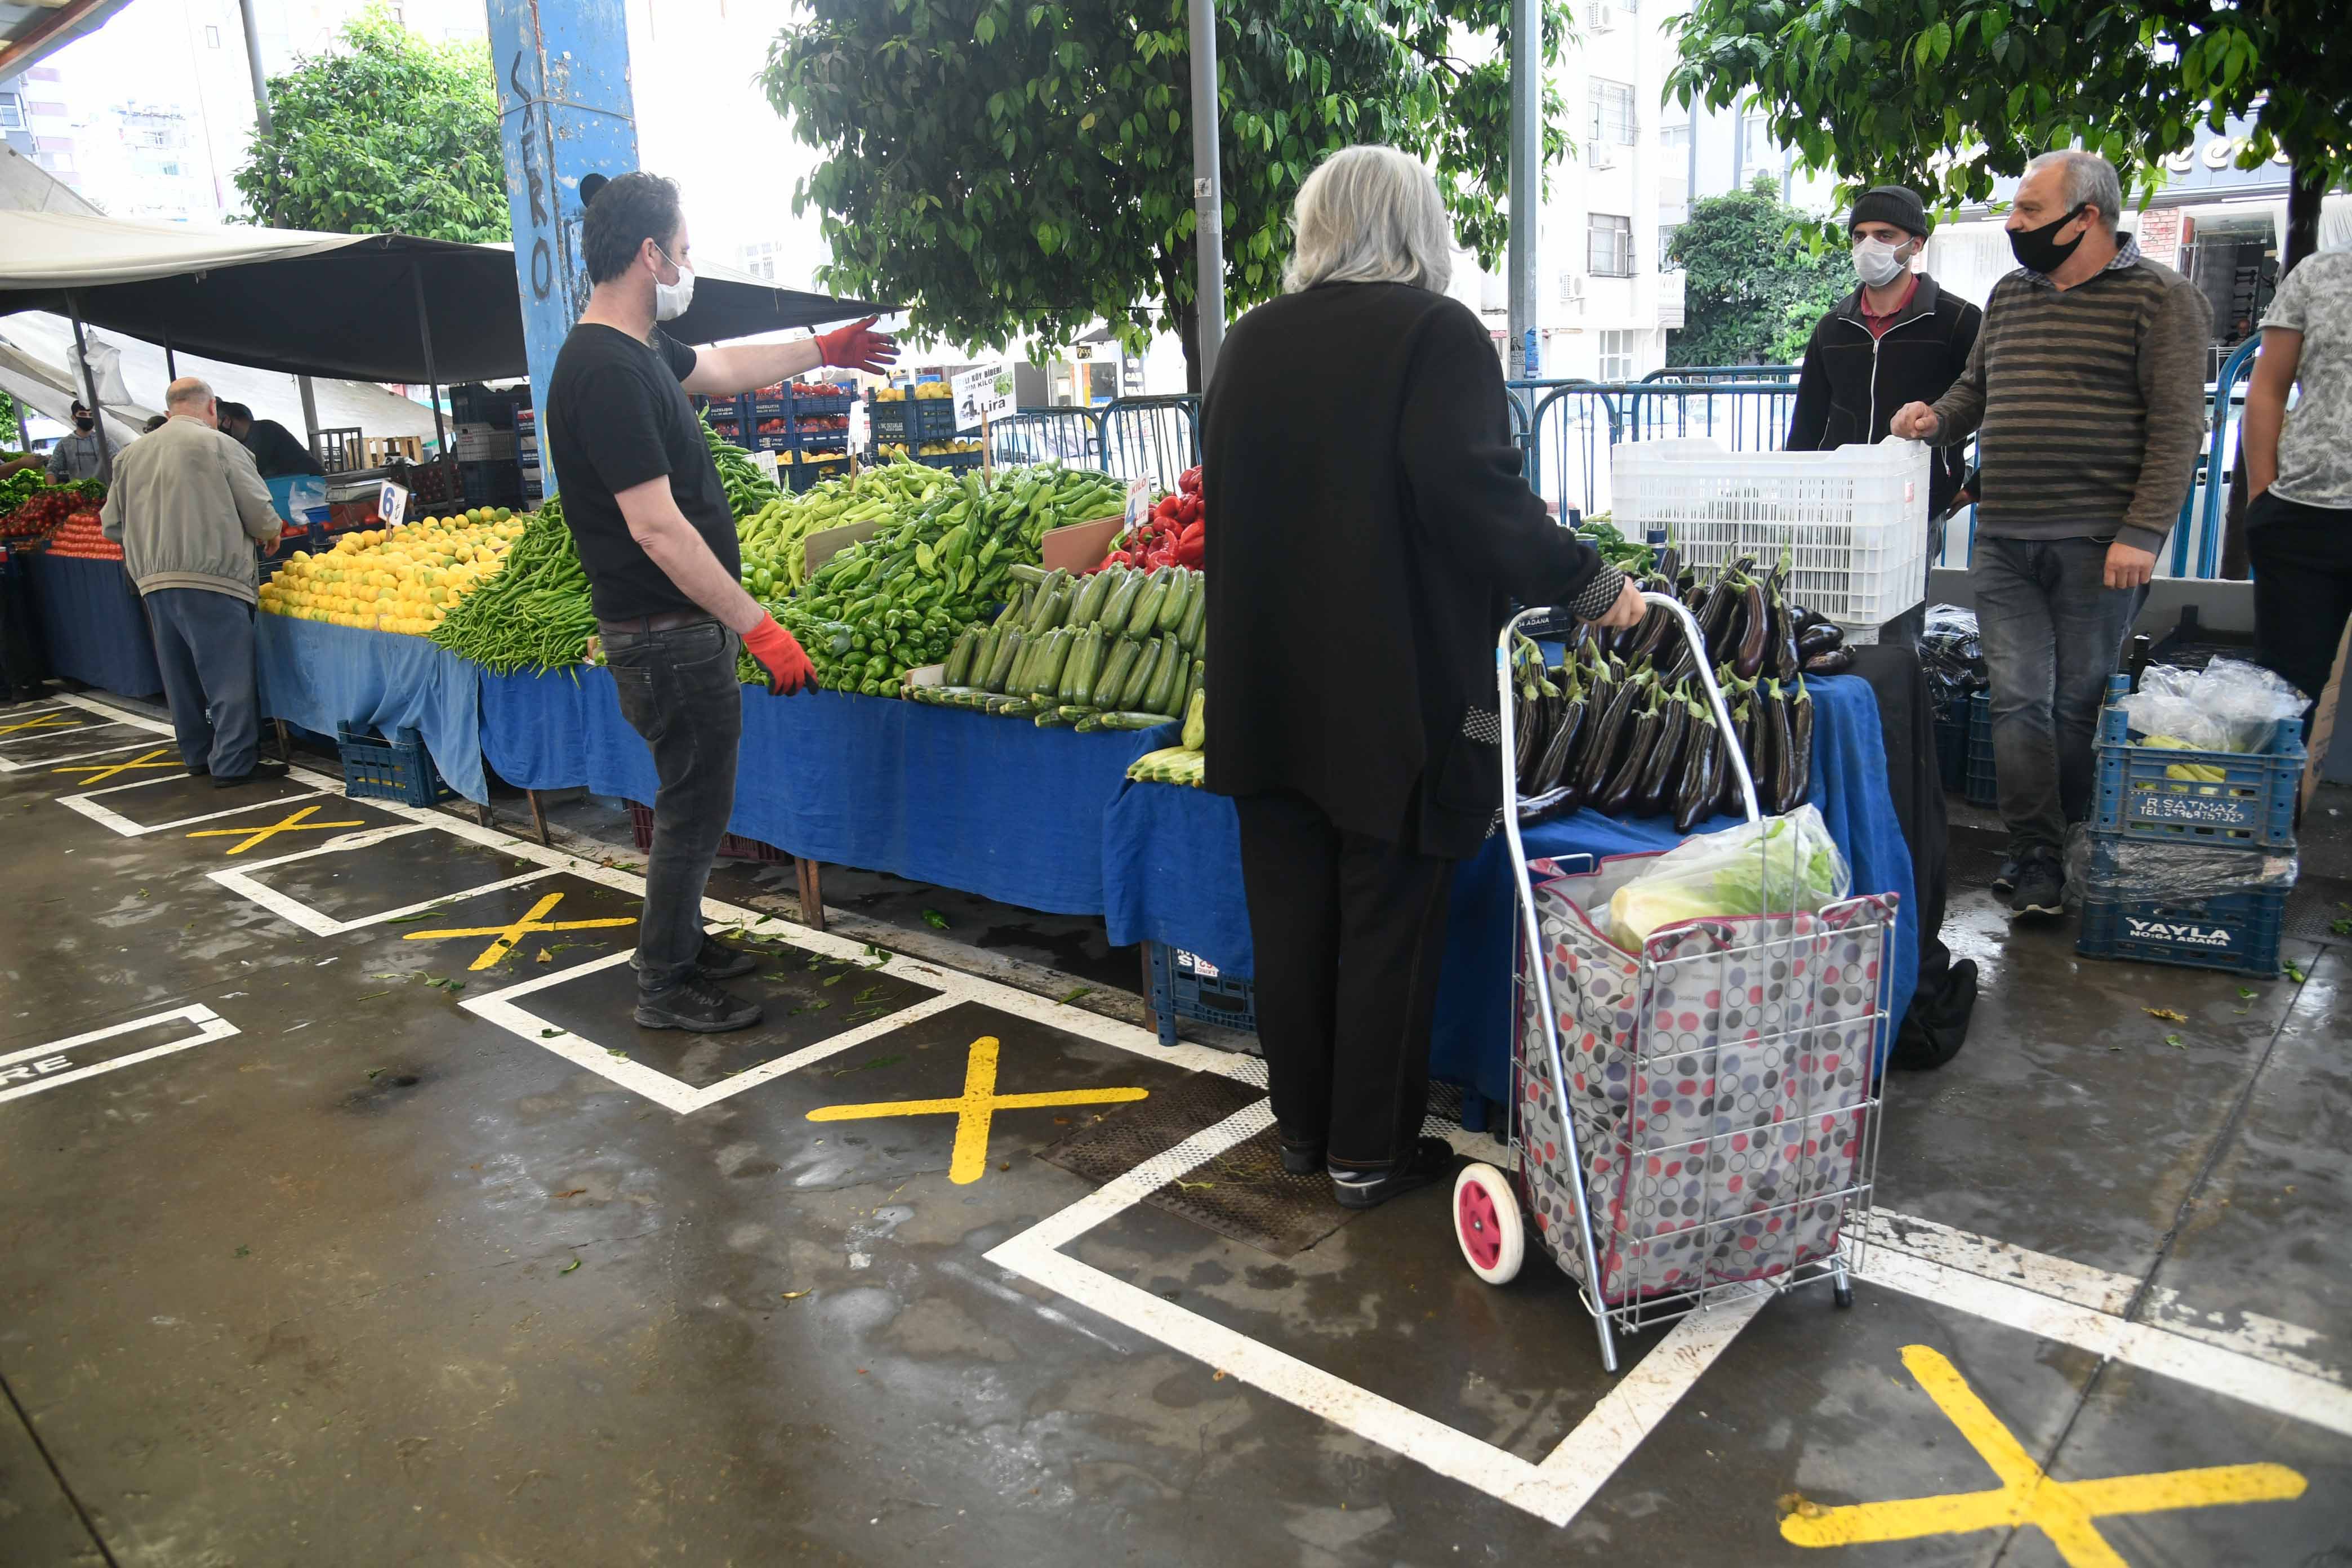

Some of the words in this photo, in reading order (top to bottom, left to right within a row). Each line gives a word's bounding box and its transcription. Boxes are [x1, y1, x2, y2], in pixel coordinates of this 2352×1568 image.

[383, 487, 395, 517] 6
[2125, 917, 2231, 941] YAYLA
[2176, 936, 2228, 946] ADANA
